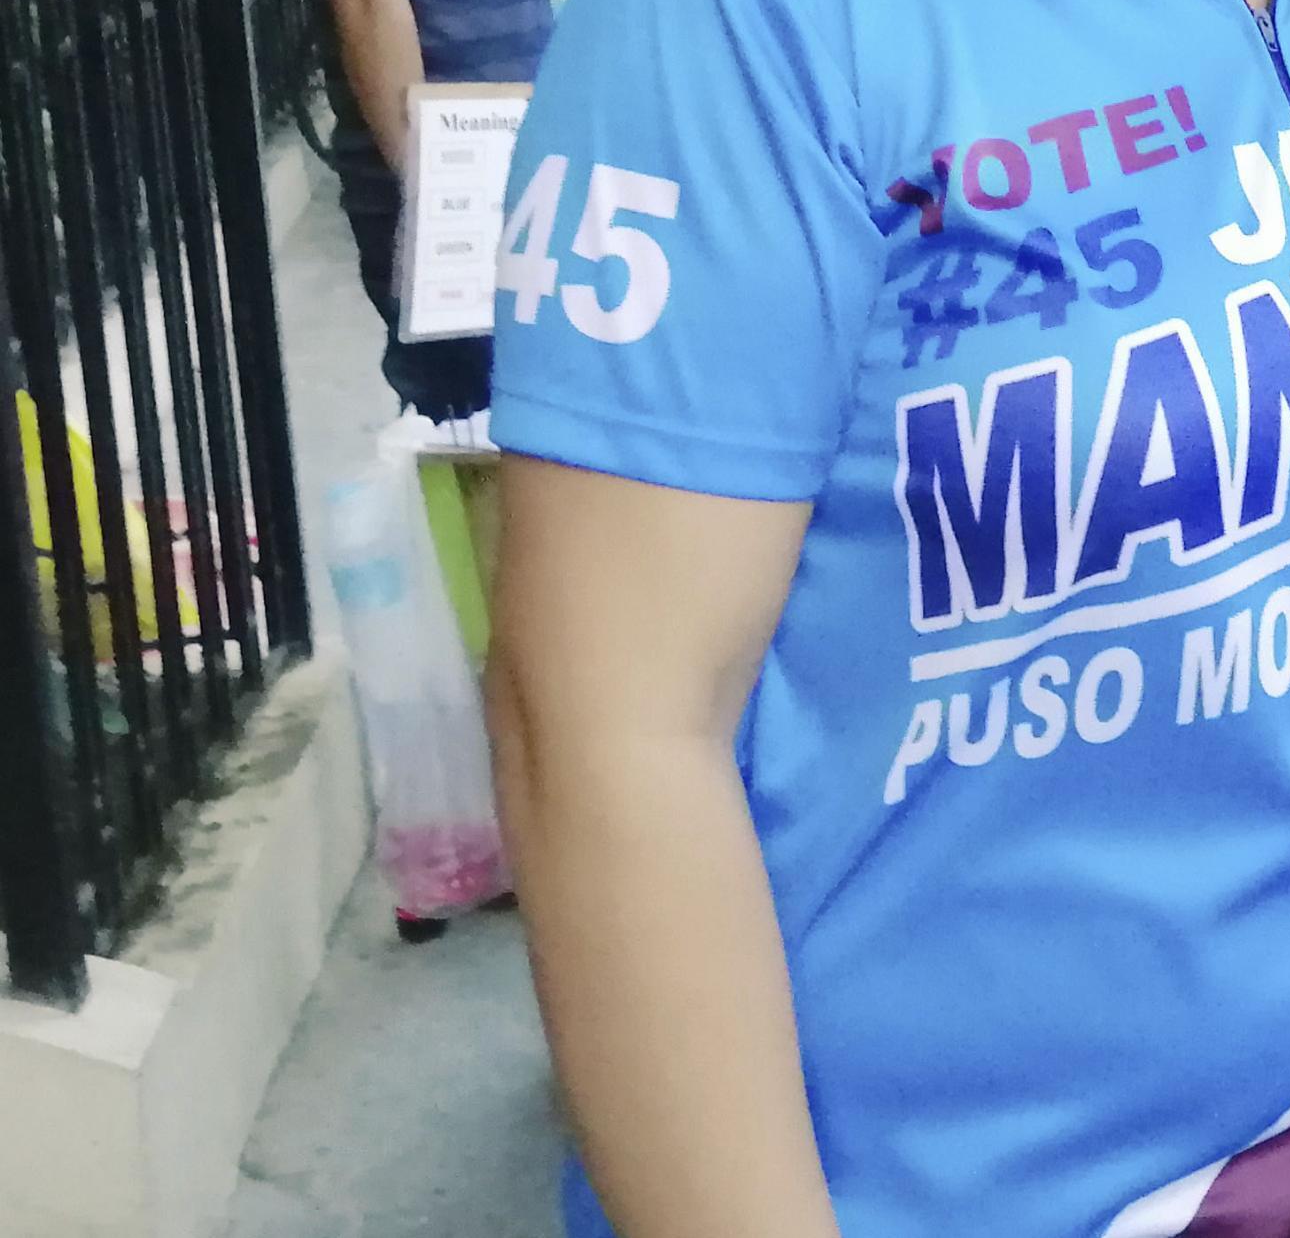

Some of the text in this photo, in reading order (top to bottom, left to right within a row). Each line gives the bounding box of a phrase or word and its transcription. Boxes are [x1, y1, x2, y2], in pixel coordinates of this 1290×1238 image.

[496, 154, 680, 344] 45
[897, 208, 1163, 369] #45
[883, 647, 1144, 804] PUSO
